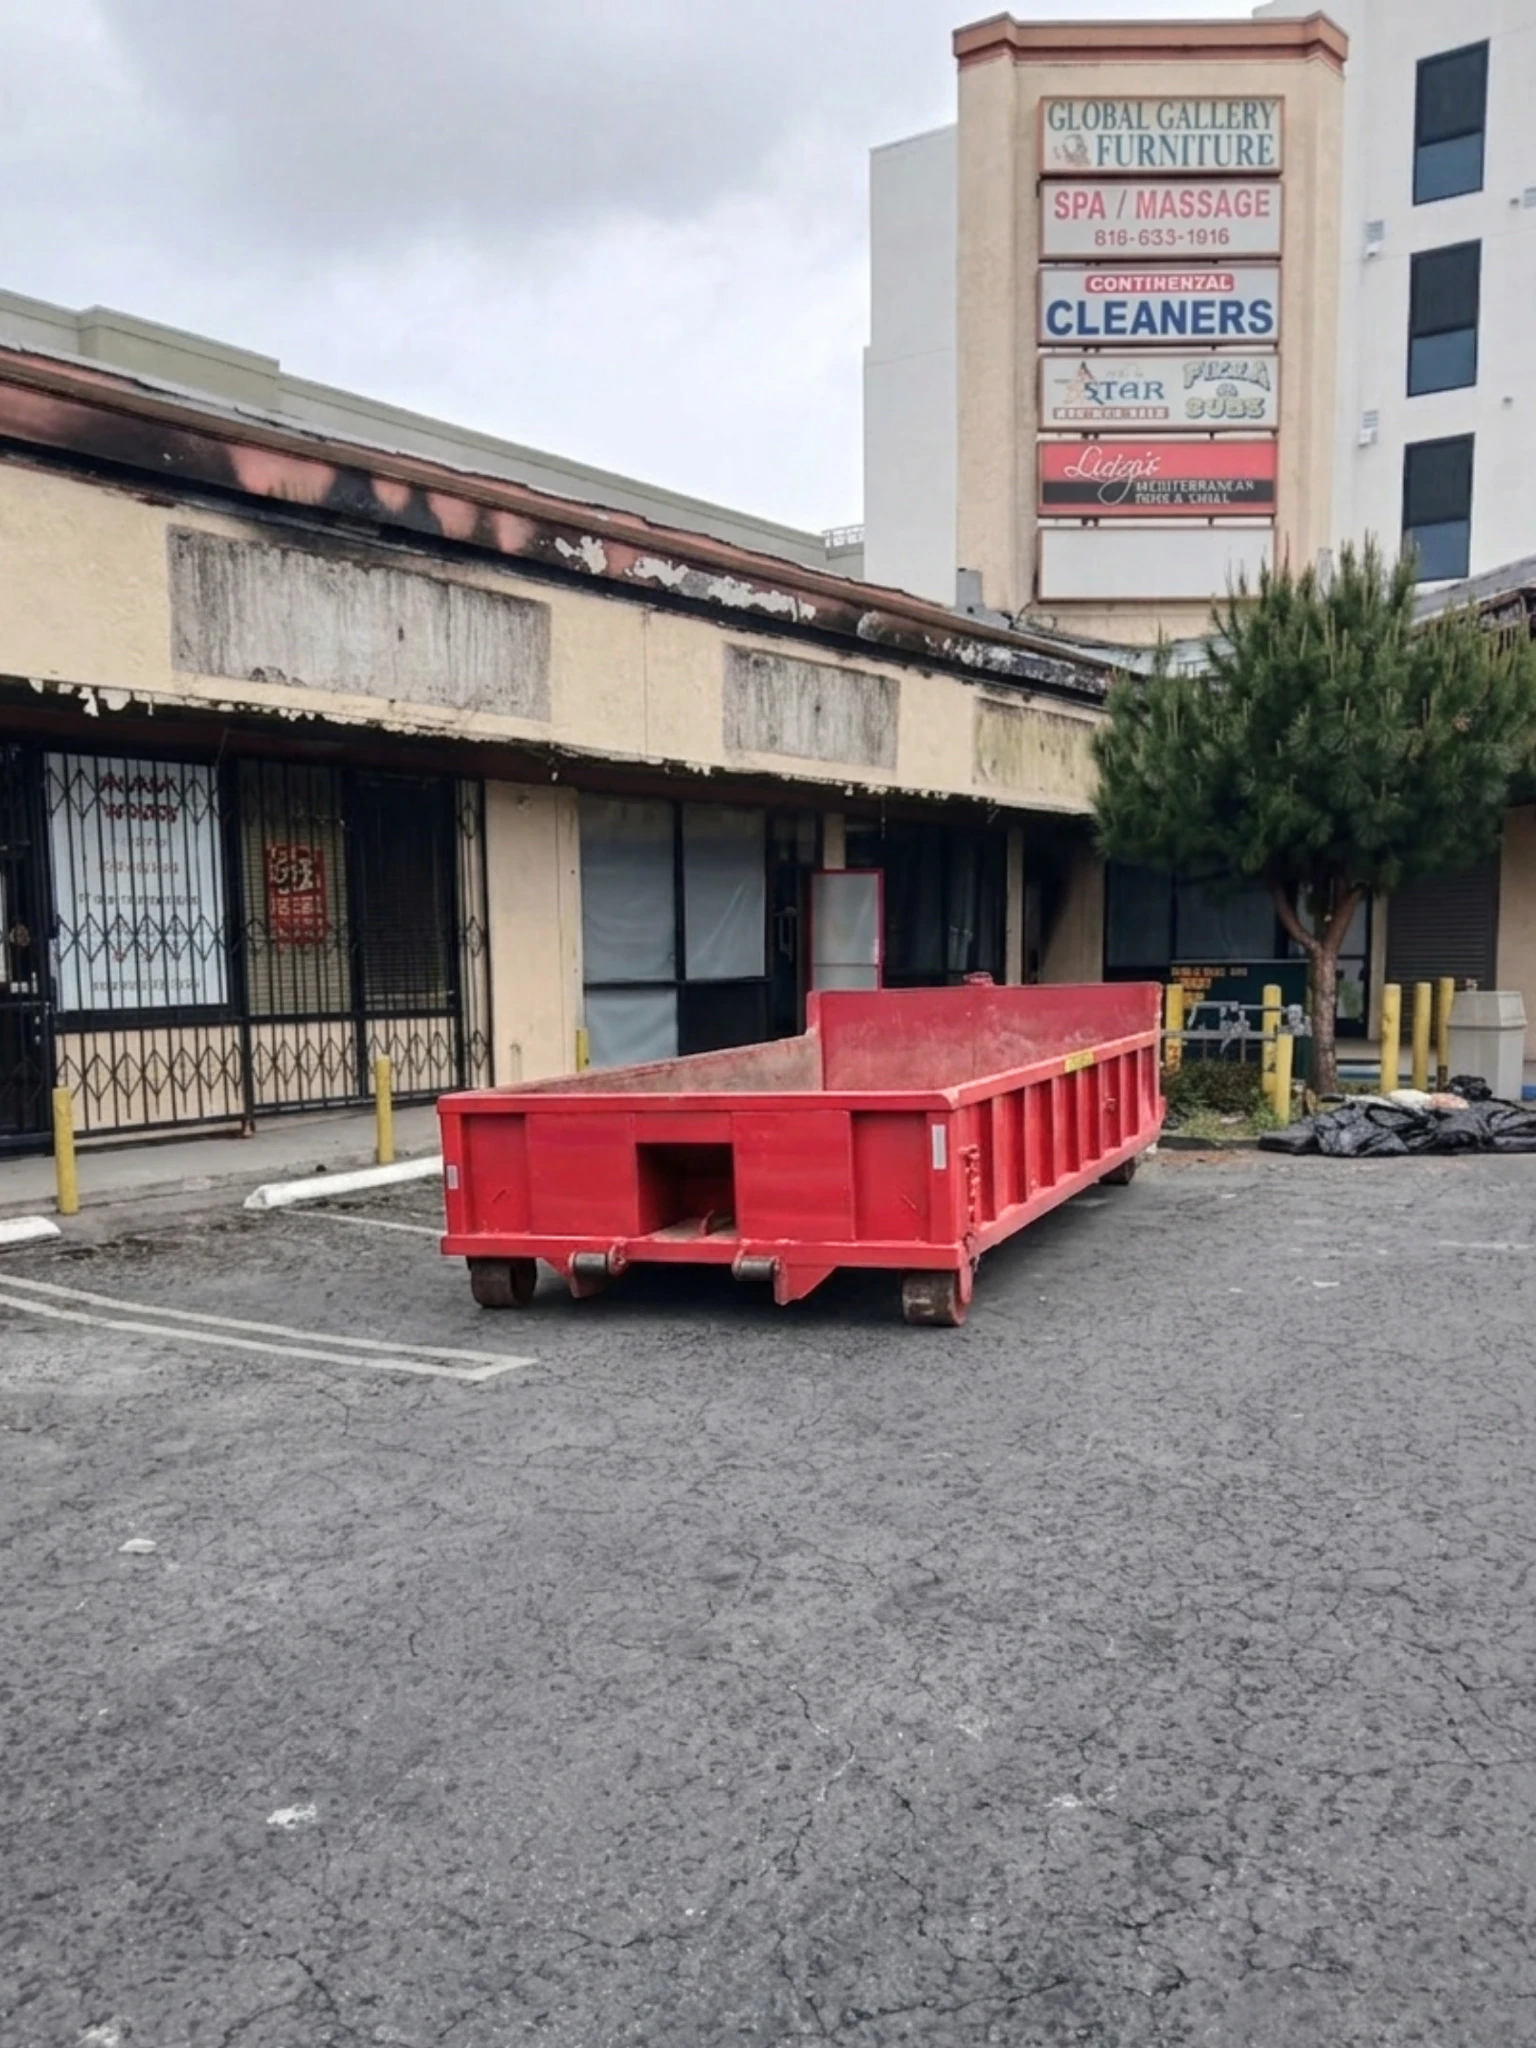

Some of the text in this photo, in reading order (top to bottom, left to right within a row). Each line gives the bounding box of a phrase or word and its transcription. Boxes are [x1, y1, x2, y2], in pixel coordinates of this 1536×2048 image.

[1048, 100, 1277, 131] GLOBAL GALLERY
[1096, 133, 1275, 167] FURNITURE
[1054, 191, 1106, 220] SPA
[1135, 189, 1270, 219] MASSAGE
[1046, 300, 1274, 336] CLEANERS
